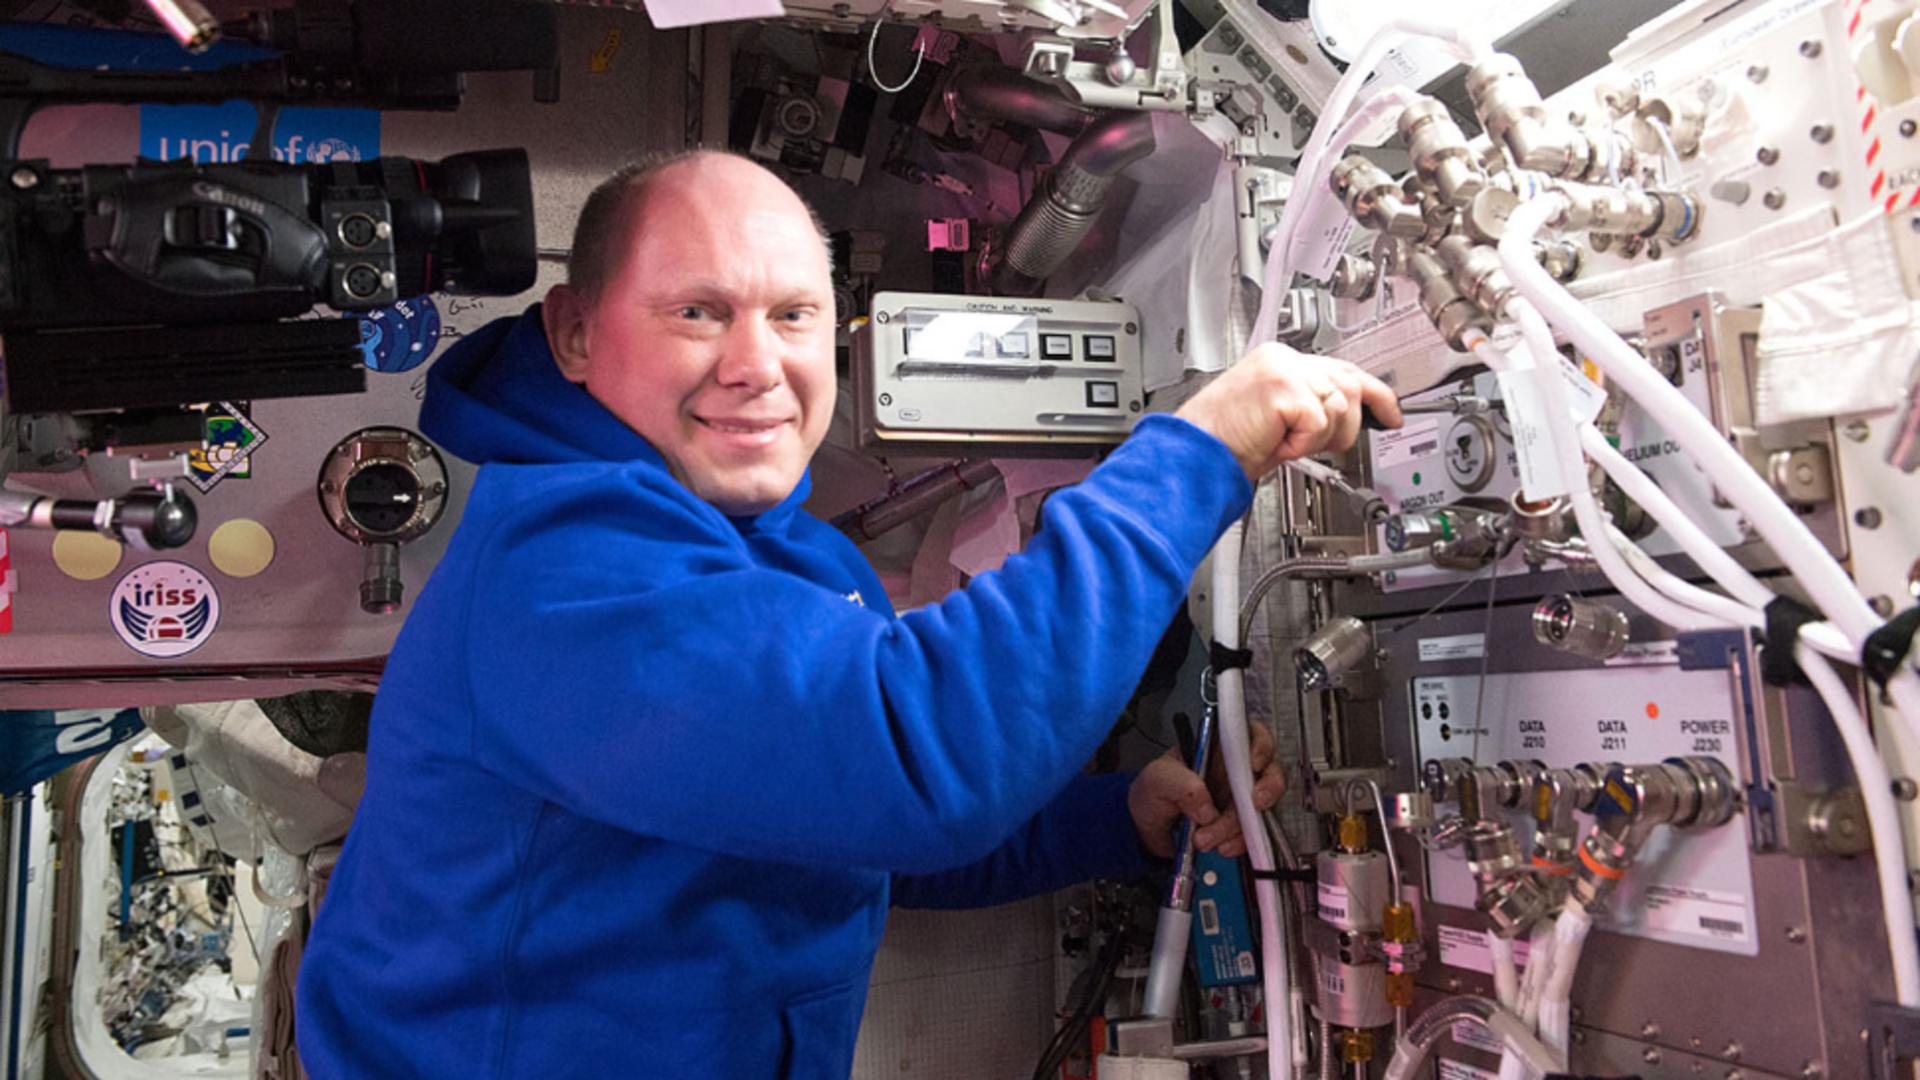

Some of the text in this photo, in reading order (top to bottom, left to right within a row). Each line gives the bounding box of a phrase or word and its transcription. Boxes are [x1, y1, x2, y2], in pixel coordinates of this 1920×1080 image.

[159, 129, 304, 166] unicf
[193, 180, 265, 215] Canon
[1401, 490, 1445, 510] ARGON OUT
[134, 582, 197, 607] iriss
[1518, 719, 1546, 734] DATA
[1597, 719, 1627, 734] DATA
[1680, 719, 1730, 735] POWER
[1601, 737, 1626, 750] J211
[1692, 737, 1722, 752] J230
